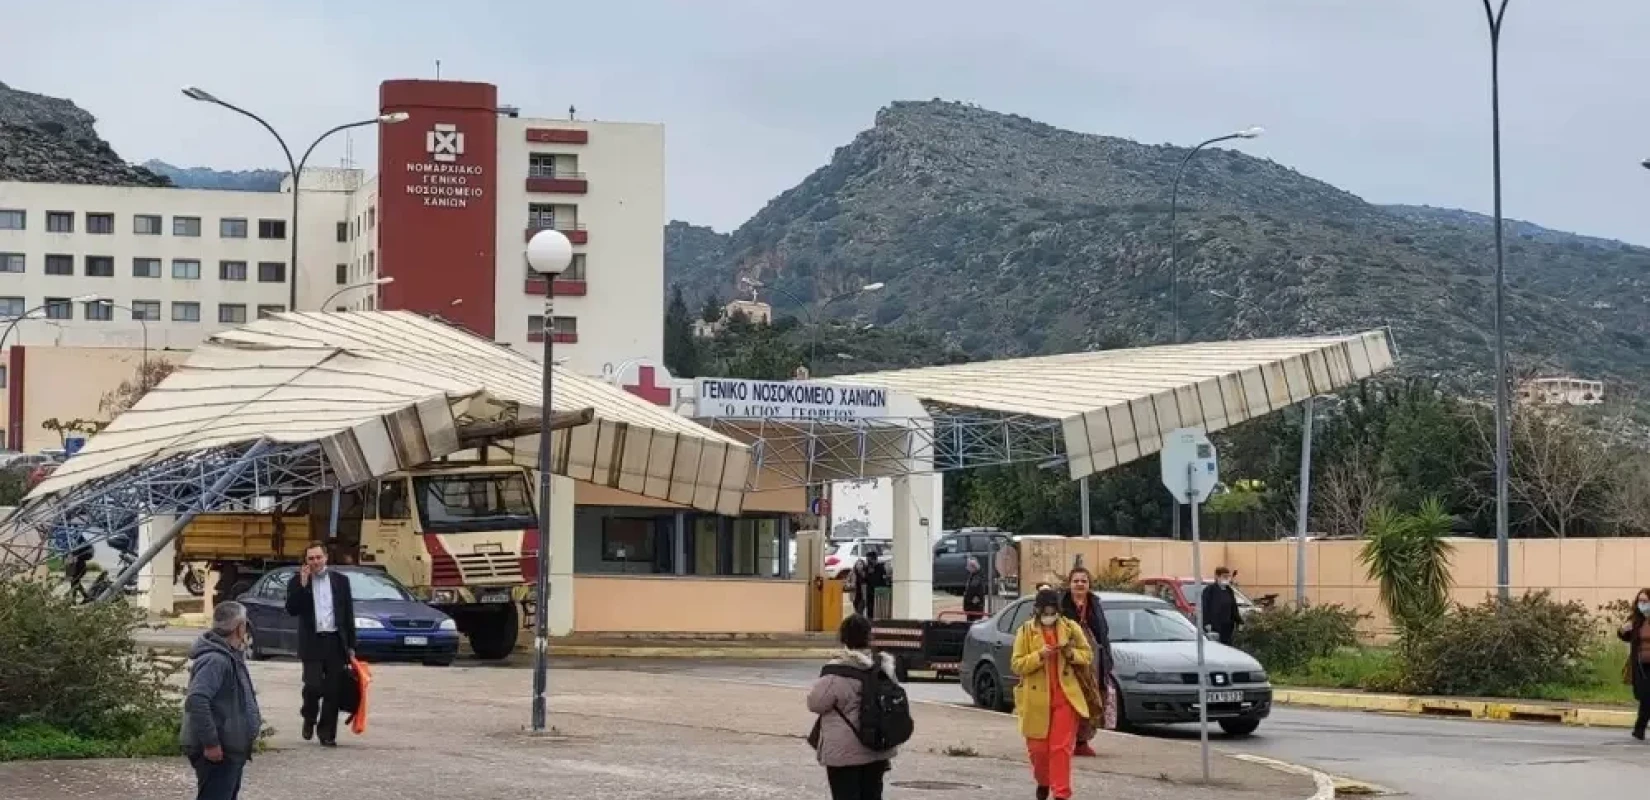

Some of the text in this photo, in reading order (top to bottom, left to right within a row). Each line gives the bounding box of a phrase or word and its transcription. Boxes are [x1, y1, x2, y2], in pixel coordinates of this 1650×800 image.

[407, 164, 482, 174] ΝΟΜΑΡΧΙΑΚΟ
[423, 175, 466, 184] ΓΕΝΙΚΟ
[406, 185, 482, 196] ΝΟΣΟΚΟΜΕΙΟ
[423, 197, 466, 207] ΧΑΝΙΩΝ
[703, 381, 887, 407] ΓΕΝΙΚΟ ΝΟΣΟΚΟΜΕΙΟ ΧΑΝΙΩΝ
